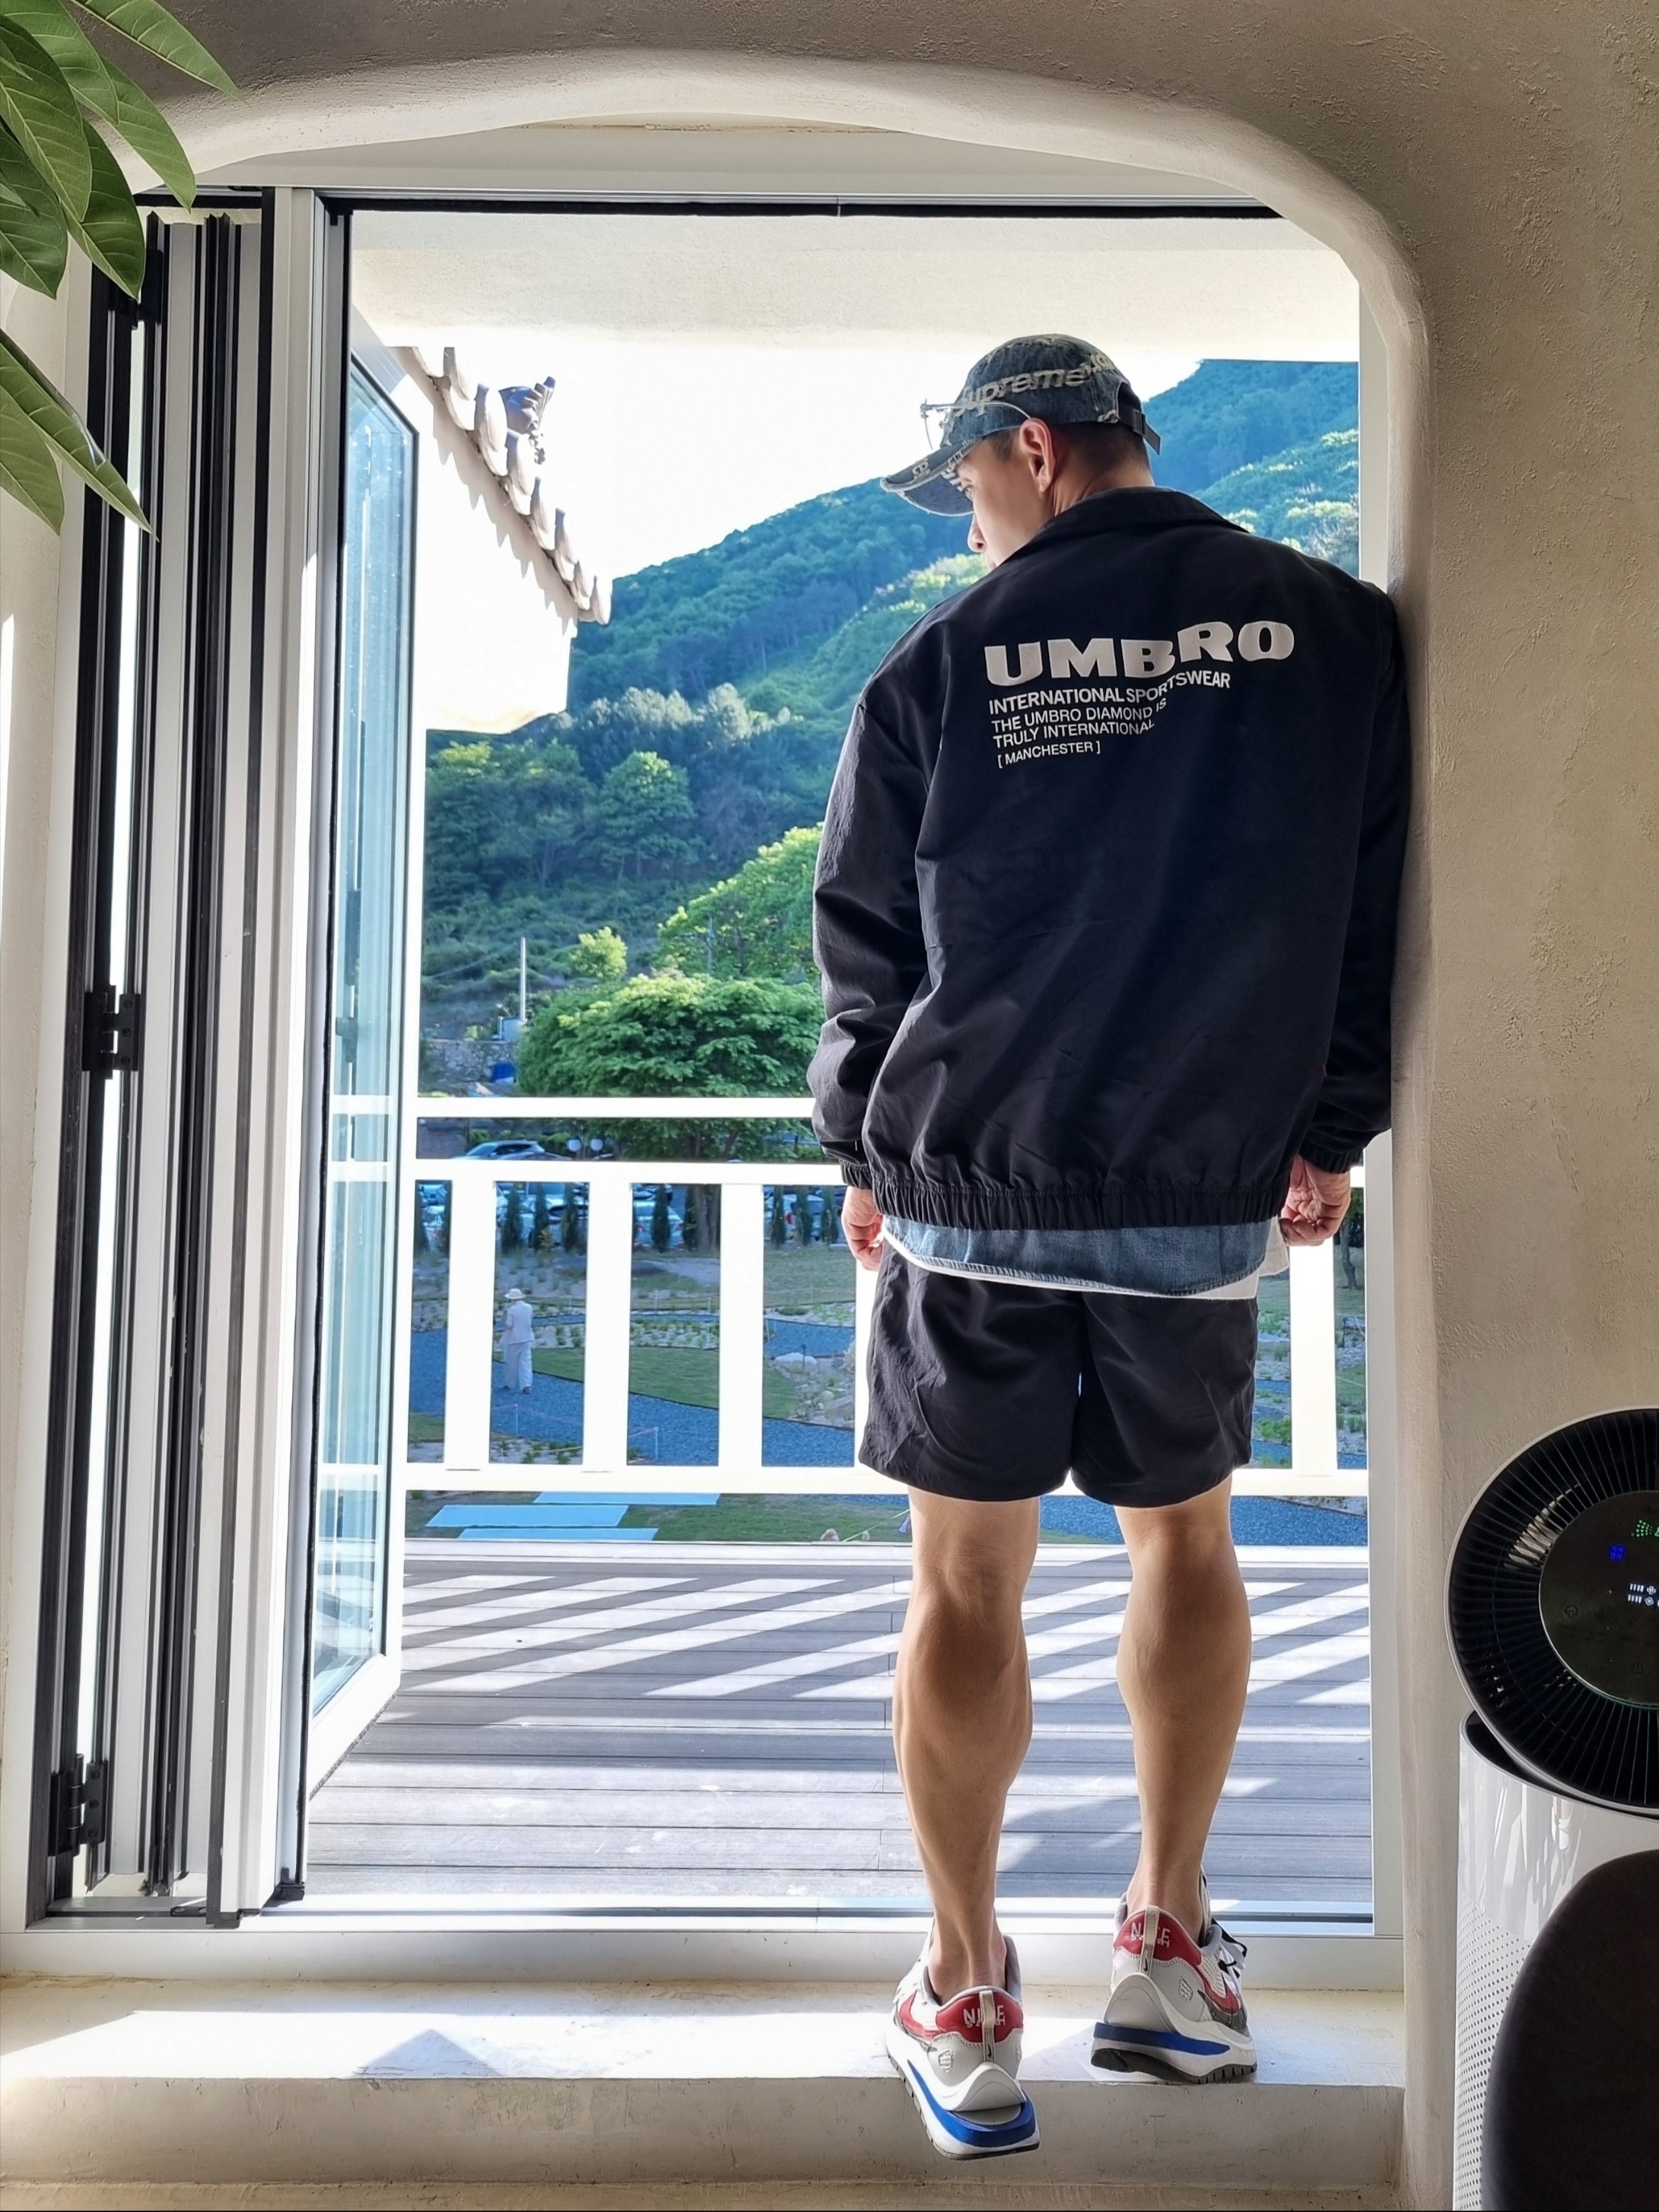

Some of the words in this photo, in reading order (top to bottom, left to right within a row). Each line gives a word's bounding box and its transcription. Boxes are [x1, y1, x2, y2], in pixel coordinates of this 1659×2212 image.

[984, 621, 1294, 686] UMBRO
[989, 688, 1125, 715] INTERNATIONAL
[1126, 670, 1231, 704] SPORTSWEAR
[991, 716, 1022, 733] THE
[1025, 708, 1082, 726] UMBRO
[1085, 707, 1152, 721] DIAMOND
[1156, 698, 1167, 712] IS
[993, 726, 1039, 748] TRULY
[1044, 719, 1155, 739] INTERNATIONAL
[1130, 1921, 1171, 1946] NE
[963, 2005, 1005, 2025] NIE
